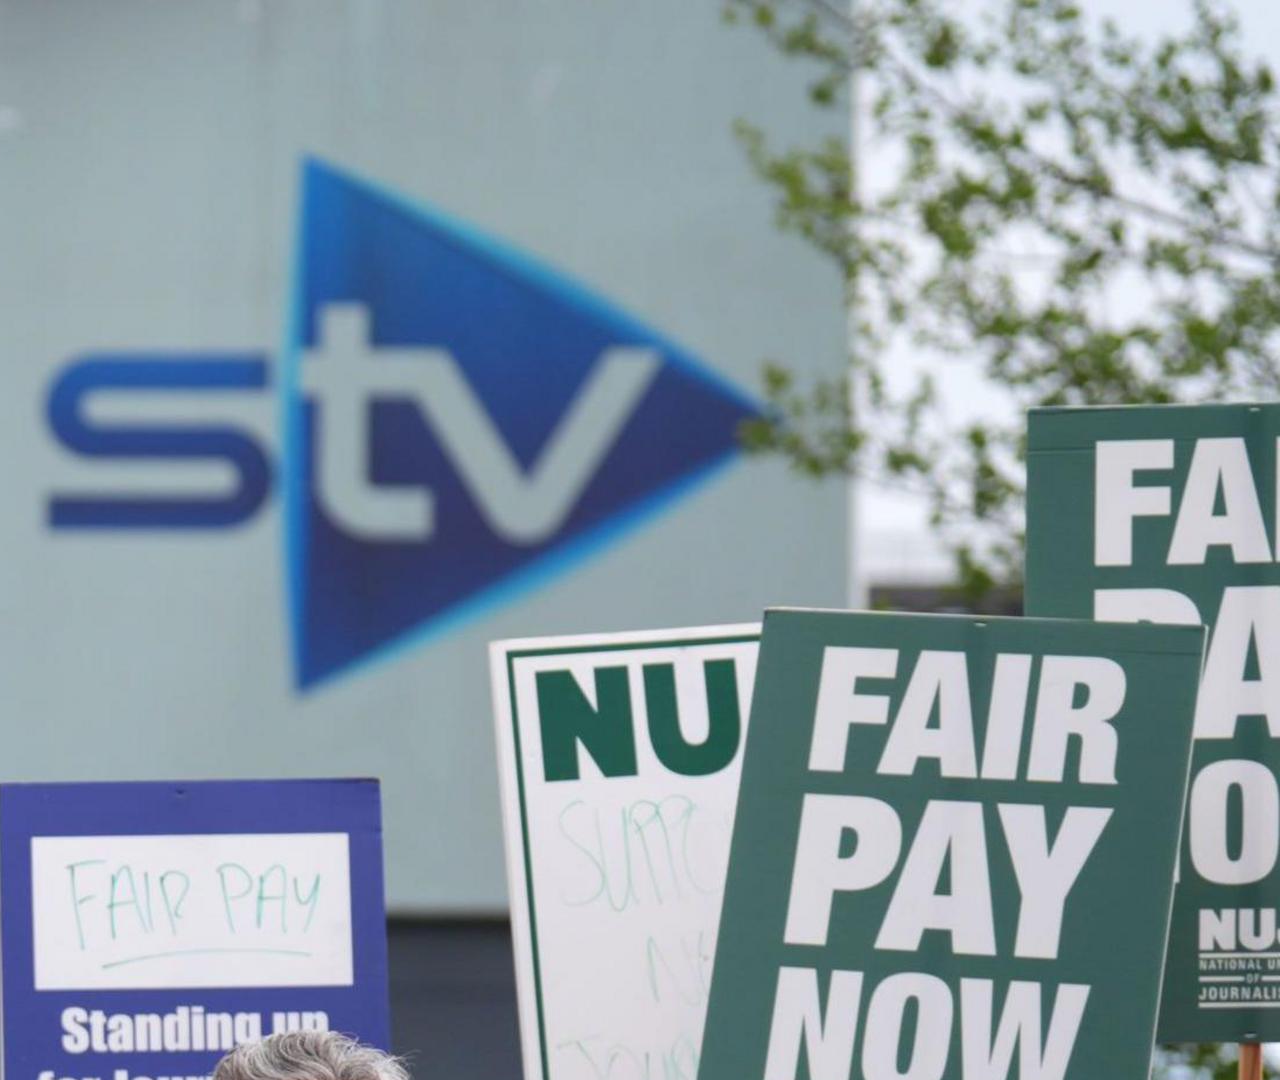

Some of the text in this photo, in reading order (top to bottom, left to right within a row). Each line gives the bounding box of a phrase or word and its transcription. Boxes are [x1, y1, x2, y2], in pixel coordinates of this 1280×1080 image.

[44, 300, 665, 545] stv
[1094, 436, 1280, 567] FA
[534, 658, 741, 783] NU
[807, 646, 1129, 785] FAIR
[65, 859, 320, 950] FAIR PAY
[783, 793, 1115, 960] PAY
[1199, 908, 1280, 951] NU
[1198, 986, 1280, 1000] JOURNALI
[1199, 959, 1262, 971] NATIONAL
